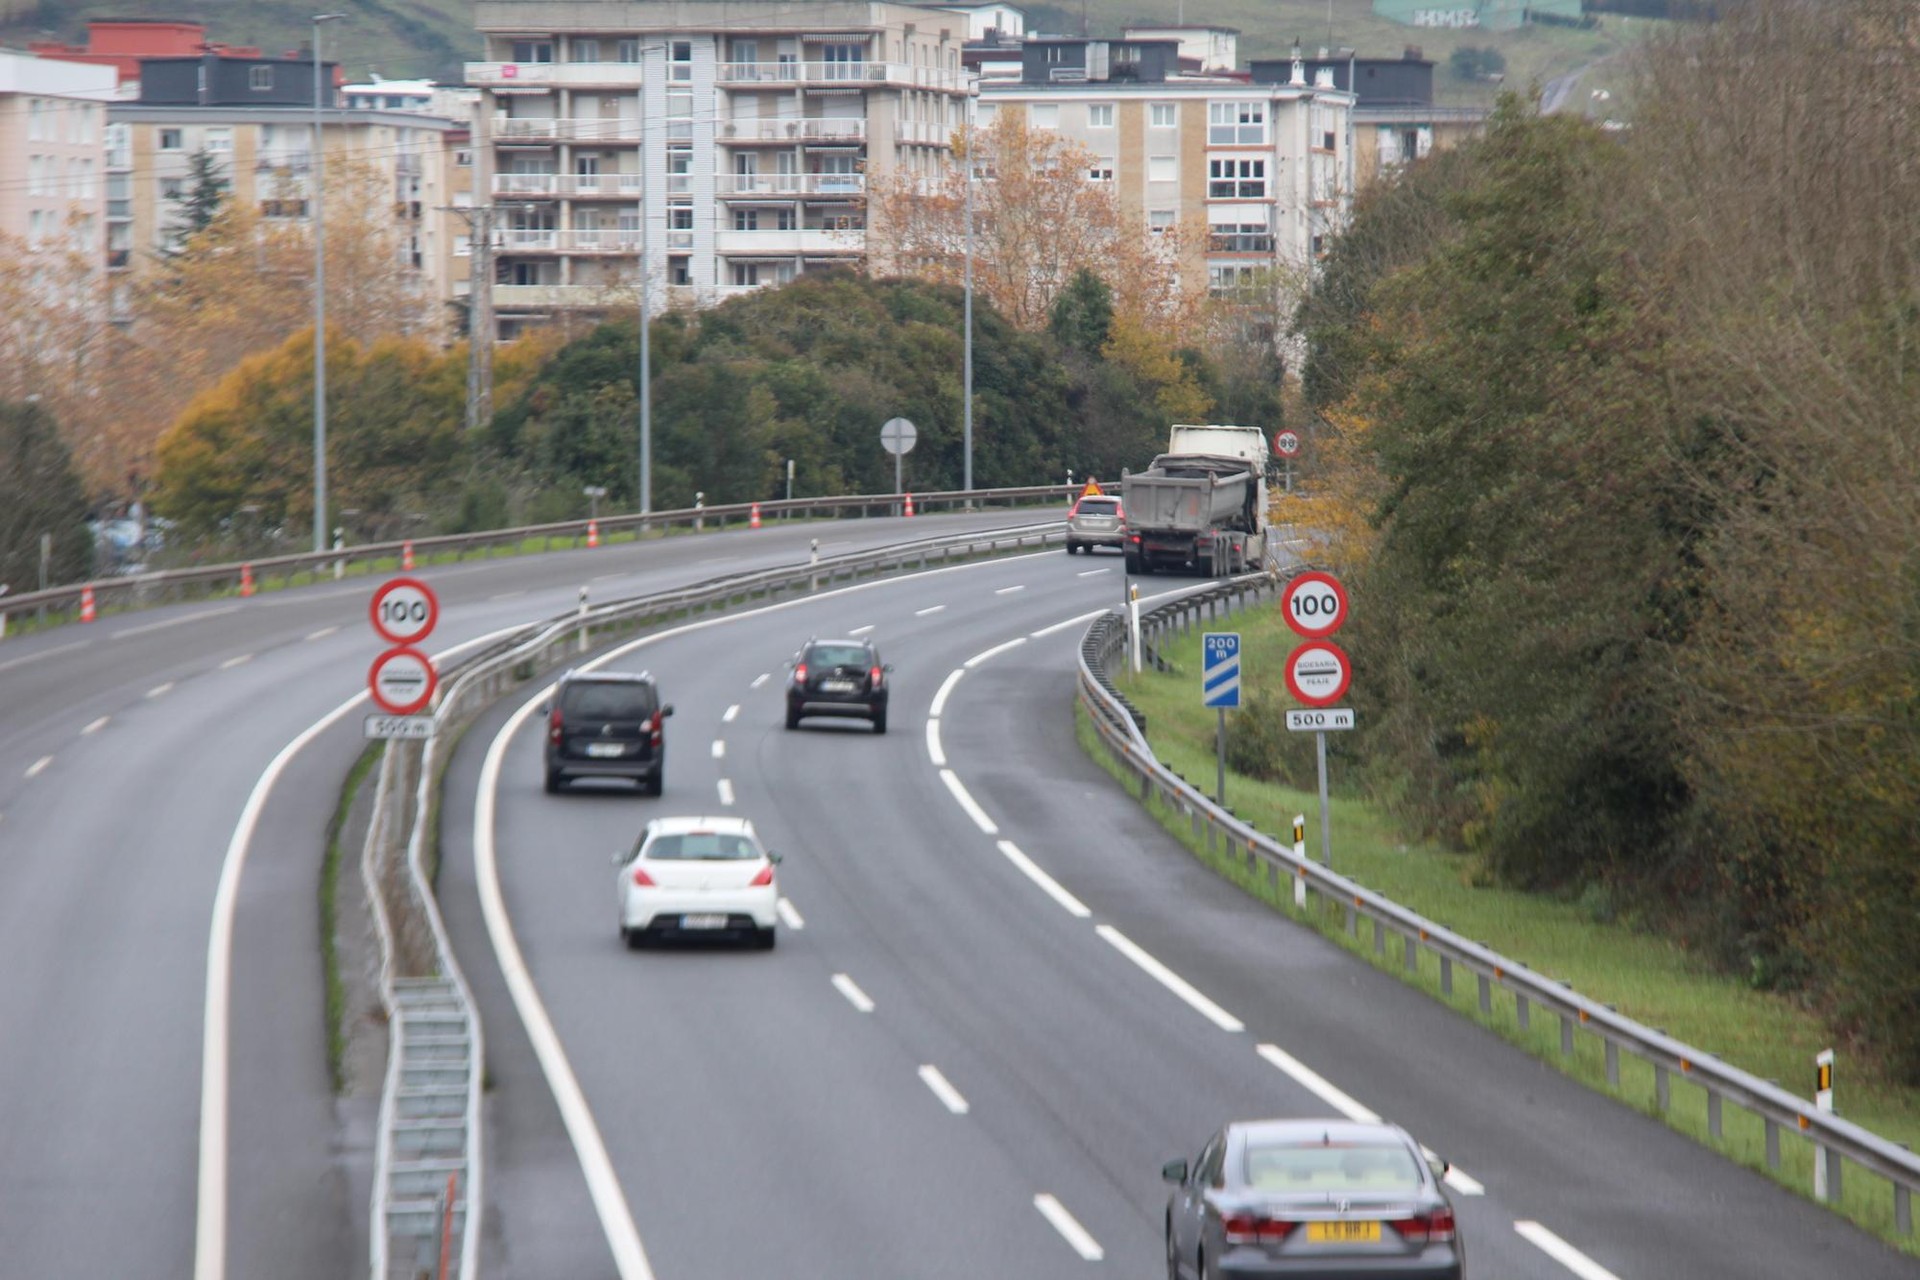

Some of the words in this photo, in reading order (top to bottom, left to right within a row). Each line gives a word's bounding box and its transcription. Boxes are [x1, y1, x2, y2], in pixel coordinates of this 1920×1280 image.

[381, 600, 427, 622] 100
[1292, 594, 1337, 616] 100
[1207, 637, 1235, 649] 200
[1216, 649, 1227, 659] m
[1293, 713, 1325, 726] 500
[1335, 714, 1348, 725] m
[376, 720, 409, 734] 500
[413, 722, 426, 734] m
